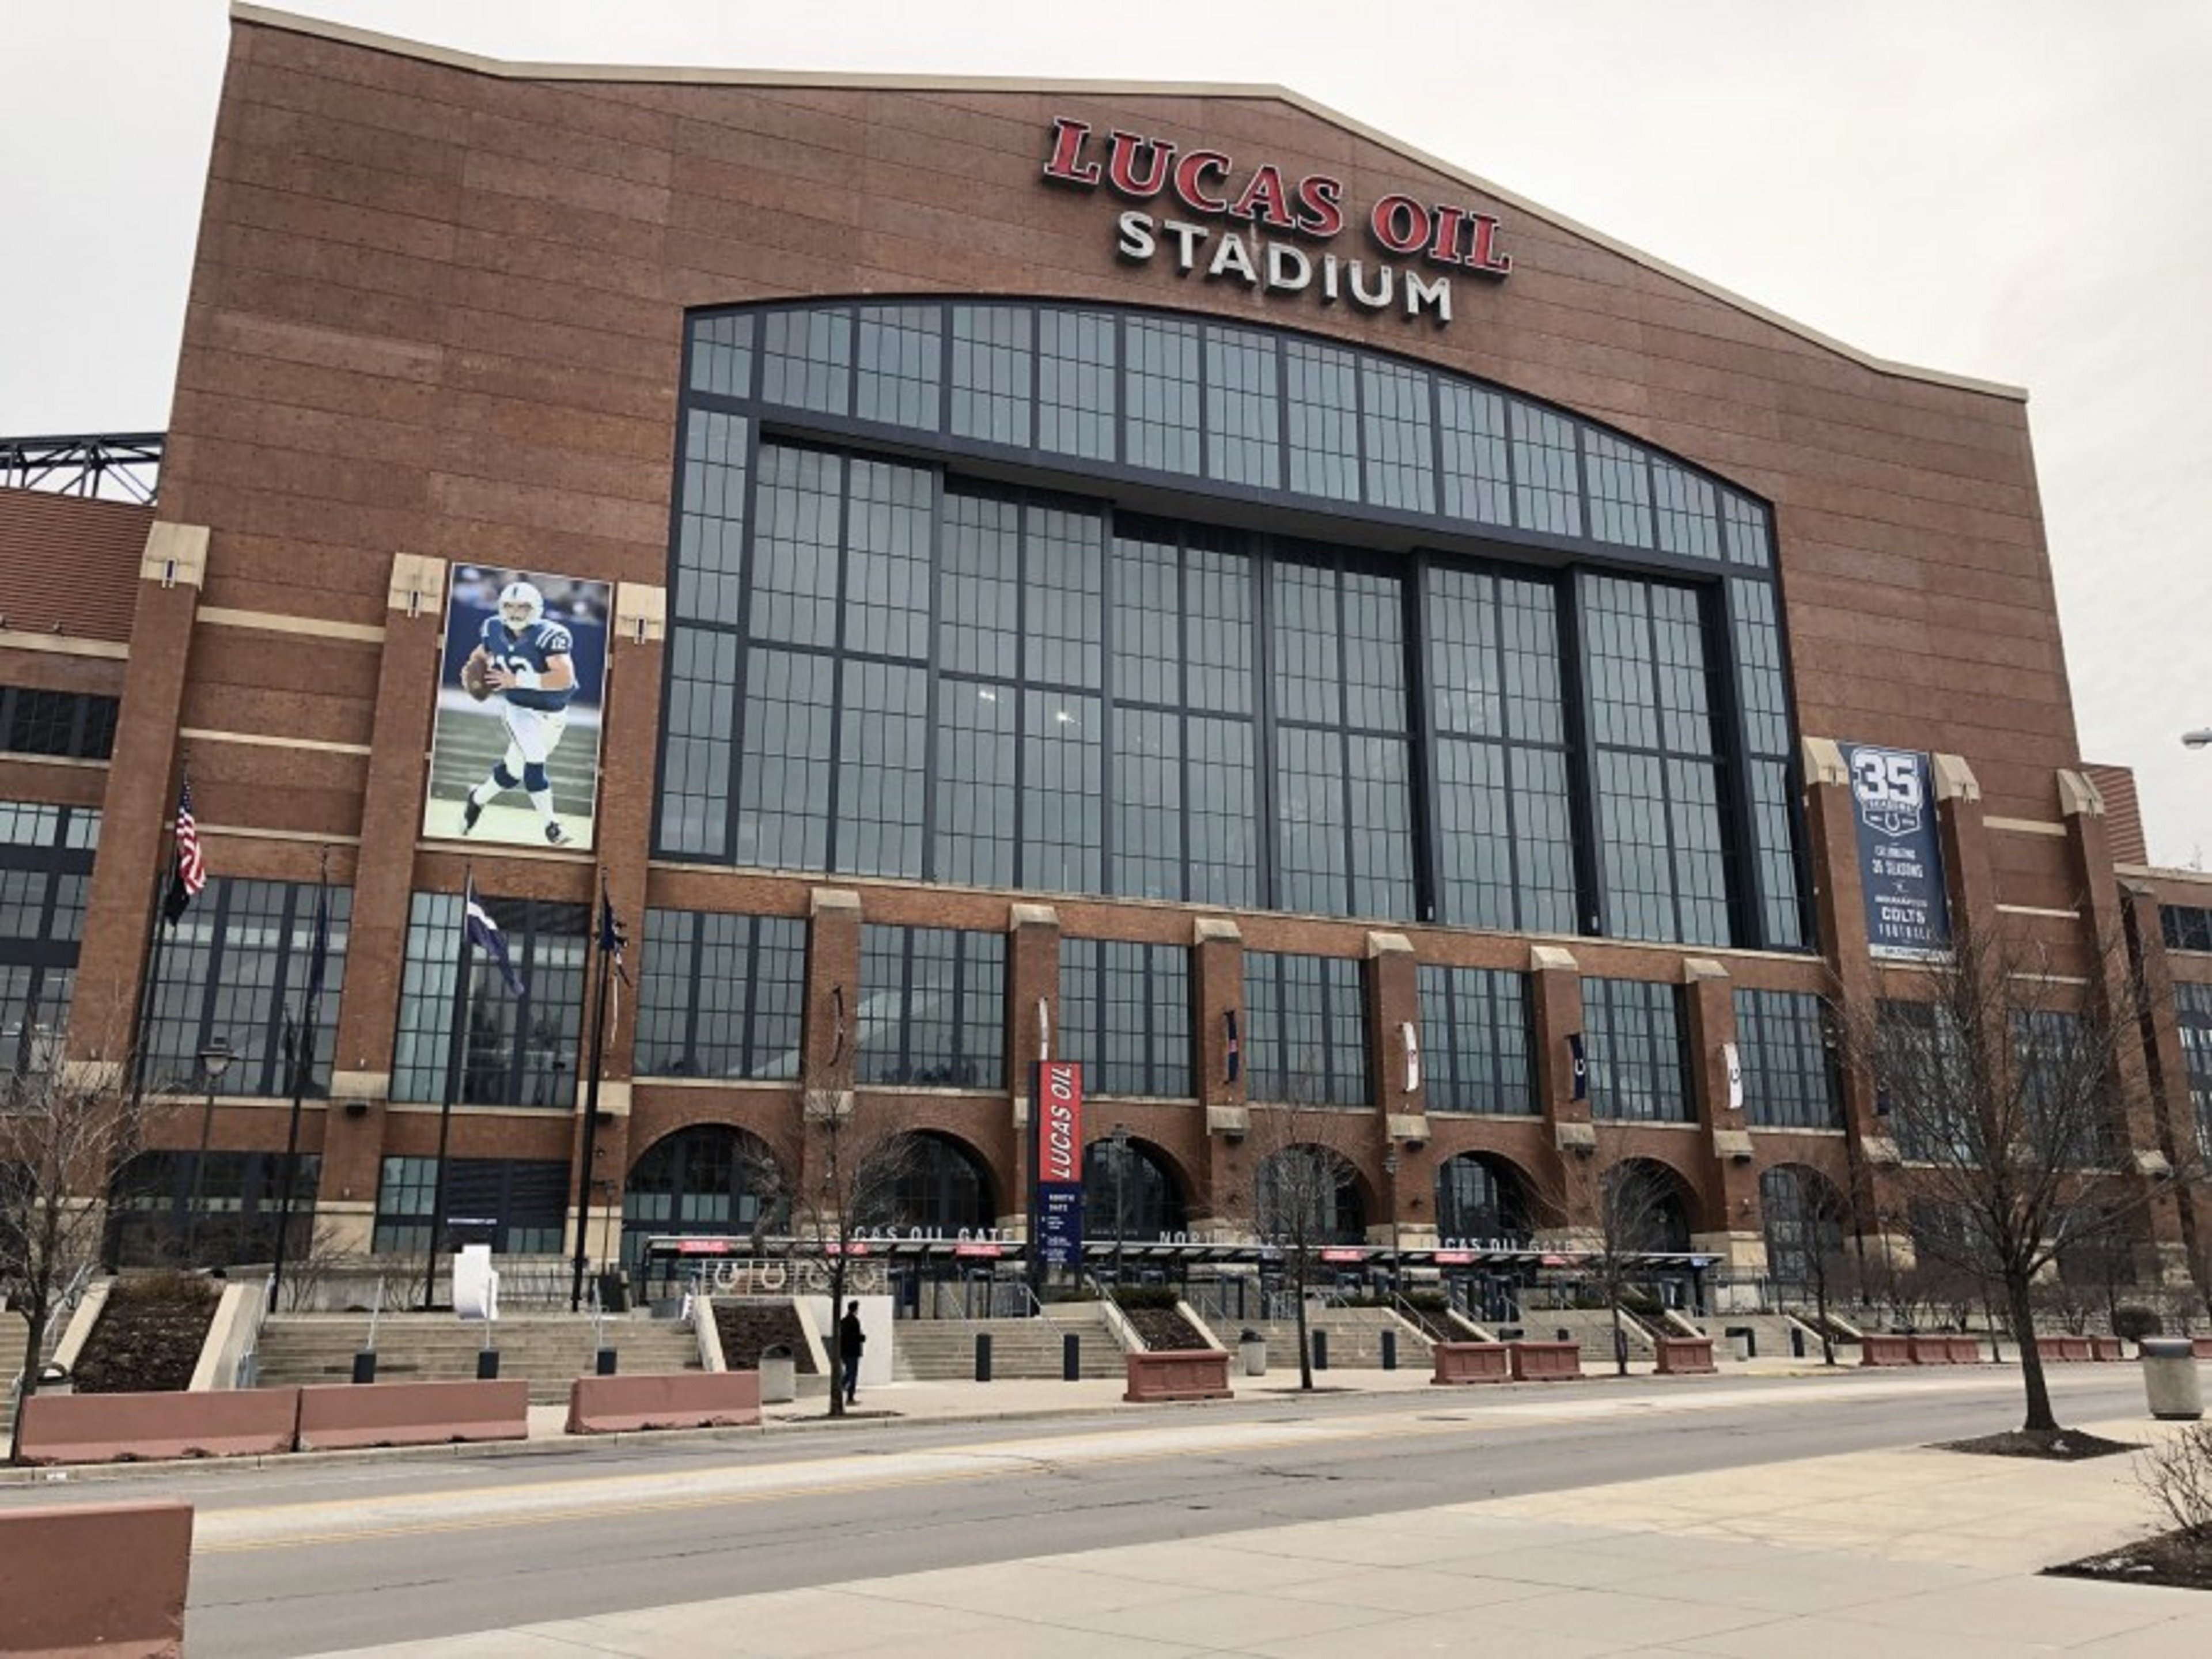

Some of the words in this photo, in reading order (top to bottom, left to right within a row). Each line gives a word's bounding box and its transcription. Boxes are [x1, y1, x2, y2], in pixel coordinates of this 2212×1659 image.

[1043, 117, 1343, 237] LUCAS
[1372, 193, 1513, 275] OIL
[1118, 210, 1453, 323] STADIUM
[551, 637, 567, 650] 12
[1853, 751, 1921, 806] 35
[1881, 906, 1925, 924] COLTS
[1051, 1067, 1071, 1100] OIL
[1051, 1105, 1071, 1179] LUCAS
[958, 1228, 1014, 1243] GATE
